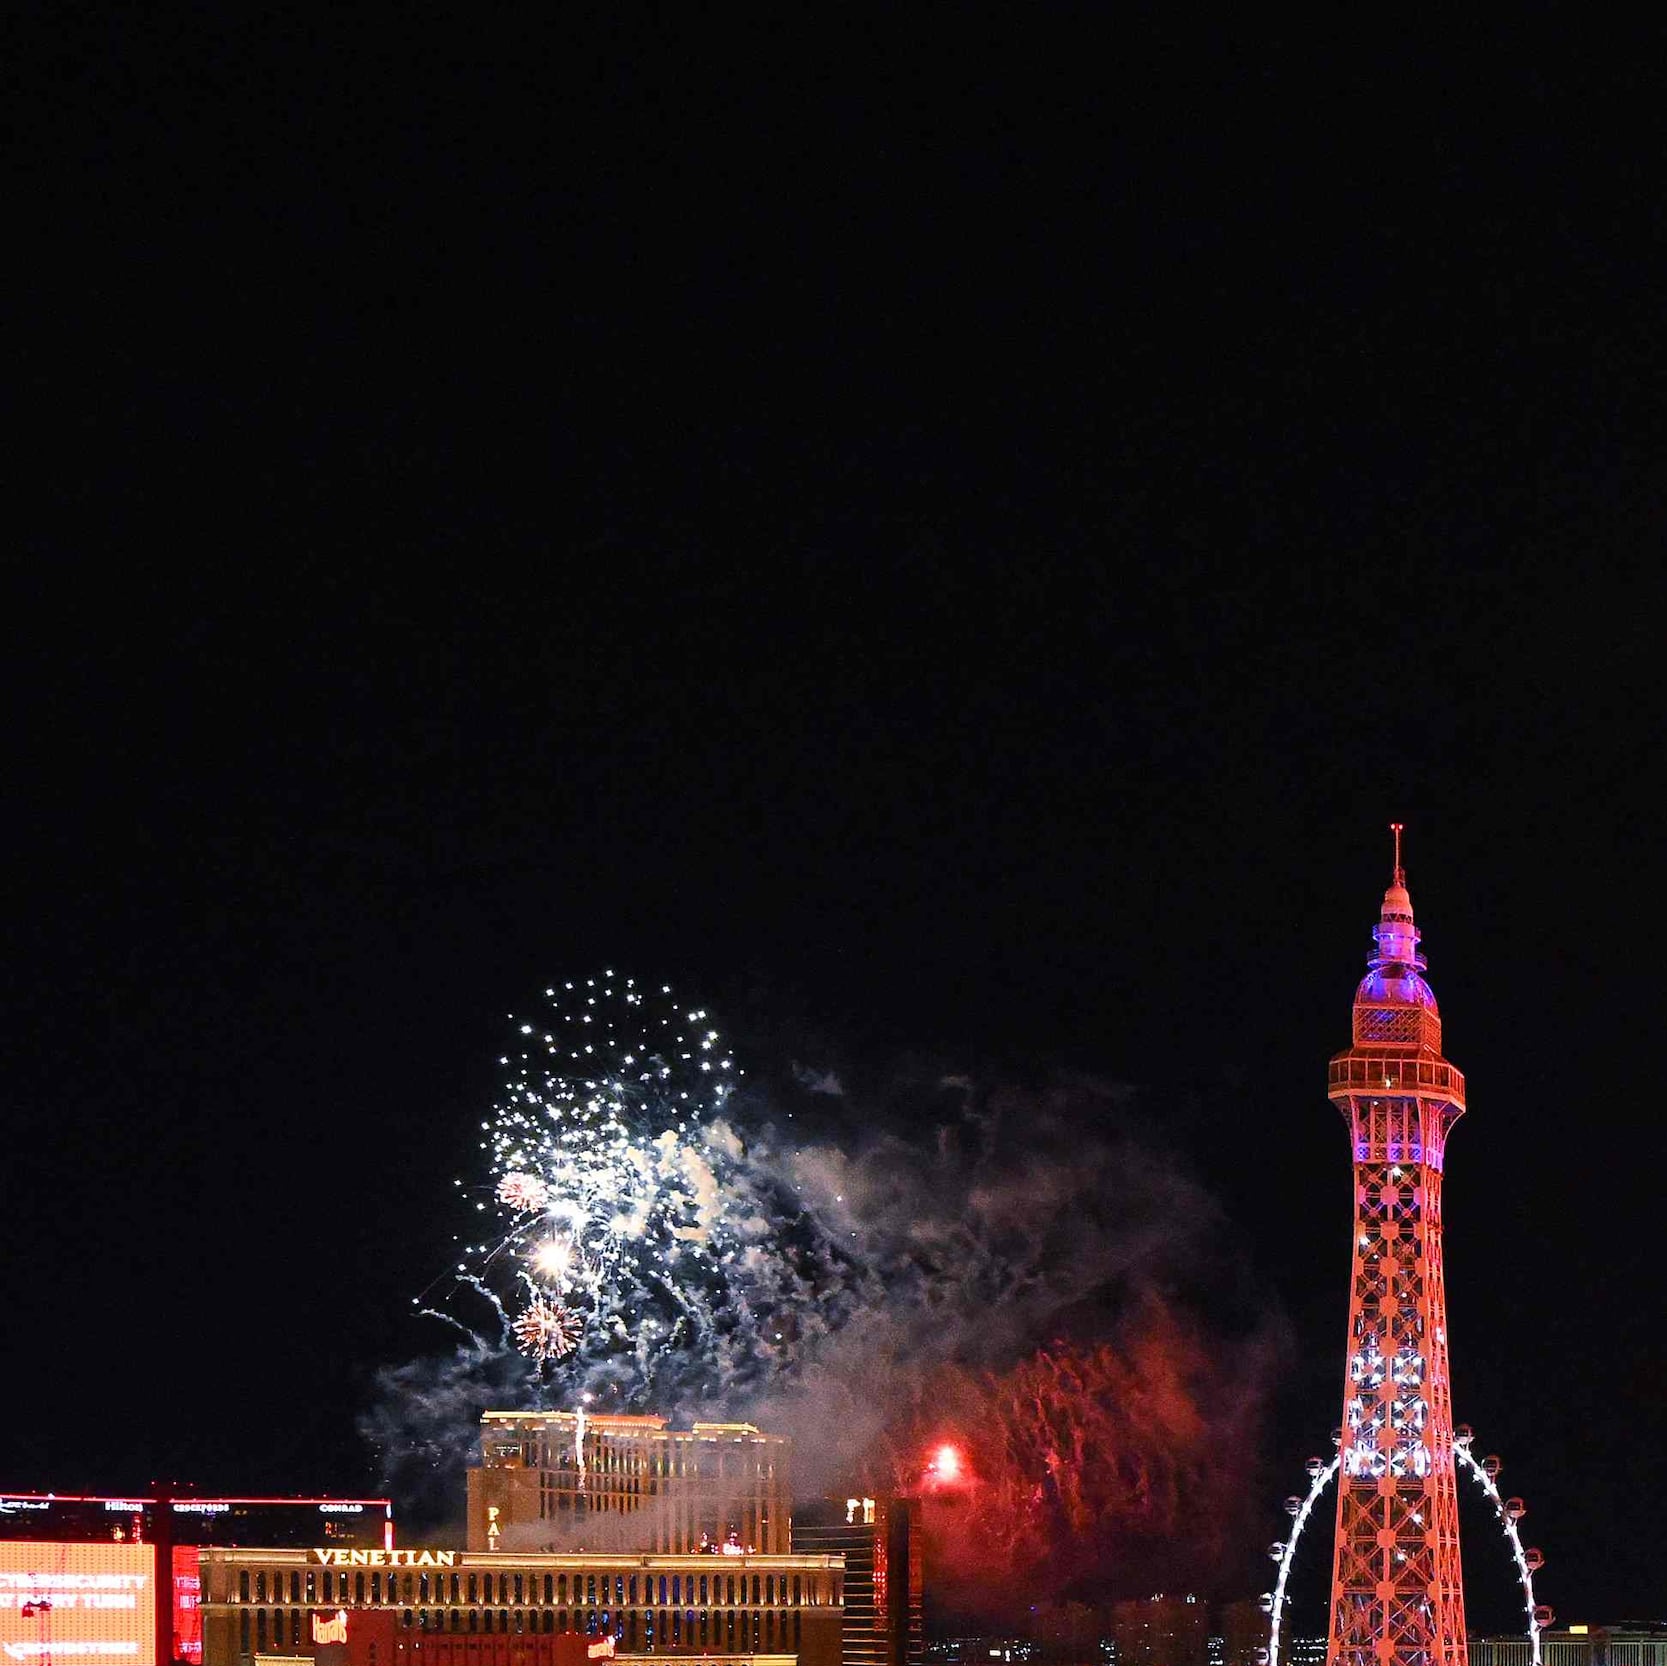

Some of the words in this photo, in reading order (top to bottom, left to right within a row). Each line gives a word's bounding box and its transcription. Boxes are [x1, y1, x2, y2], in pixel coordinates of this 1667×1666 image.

[105, 1501, 144, 1512] Hilton
[319, 1504, 364, 1513] CONRAD
[313, 1547, 456, 1567] VENETIAN
